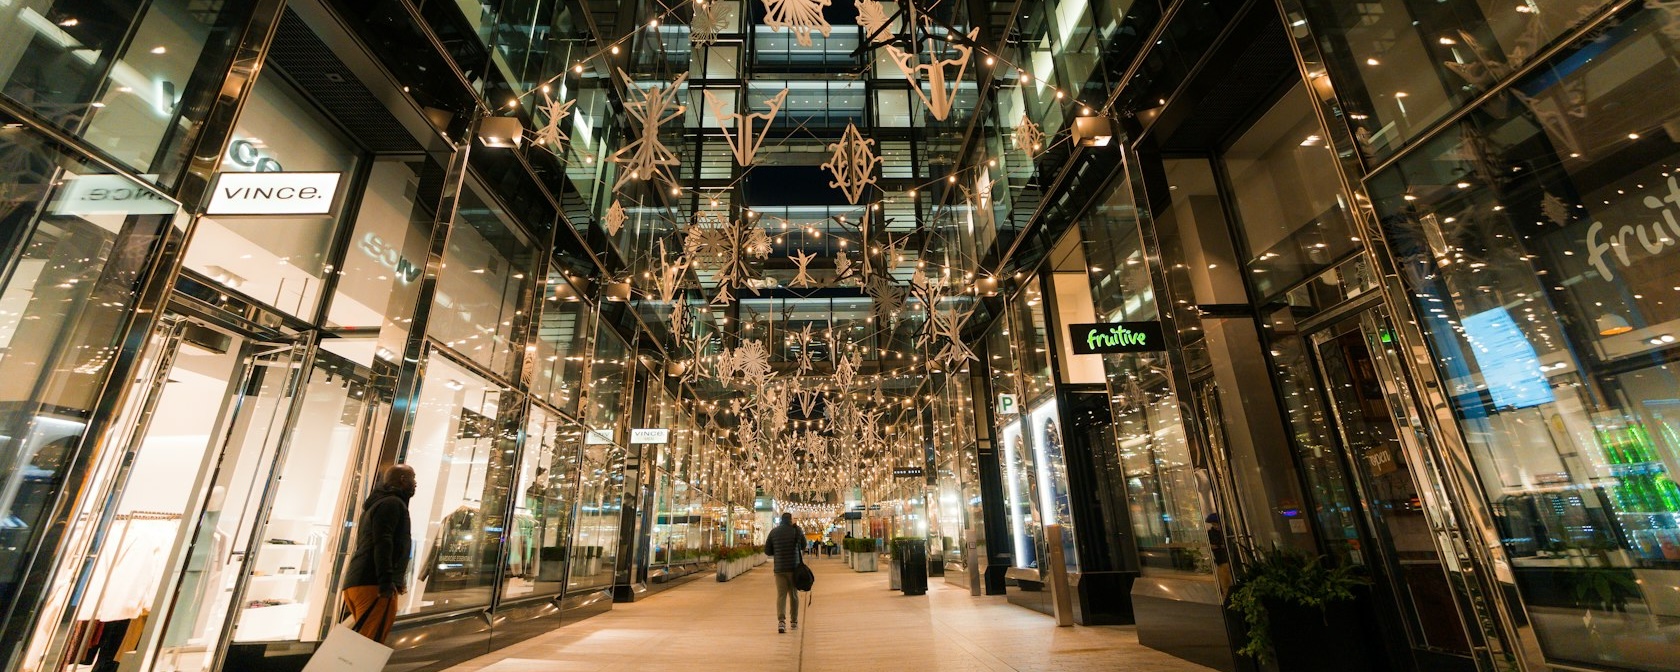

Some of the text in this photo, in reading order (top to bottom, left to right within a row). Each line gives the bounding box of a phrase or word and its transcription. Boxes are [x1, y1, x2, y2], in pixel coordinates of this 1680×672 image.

[1087, 325, 1146, 350] fruitive
[1002, 396, 1013, 411] P
[1370, 451, 1390, 471] open
